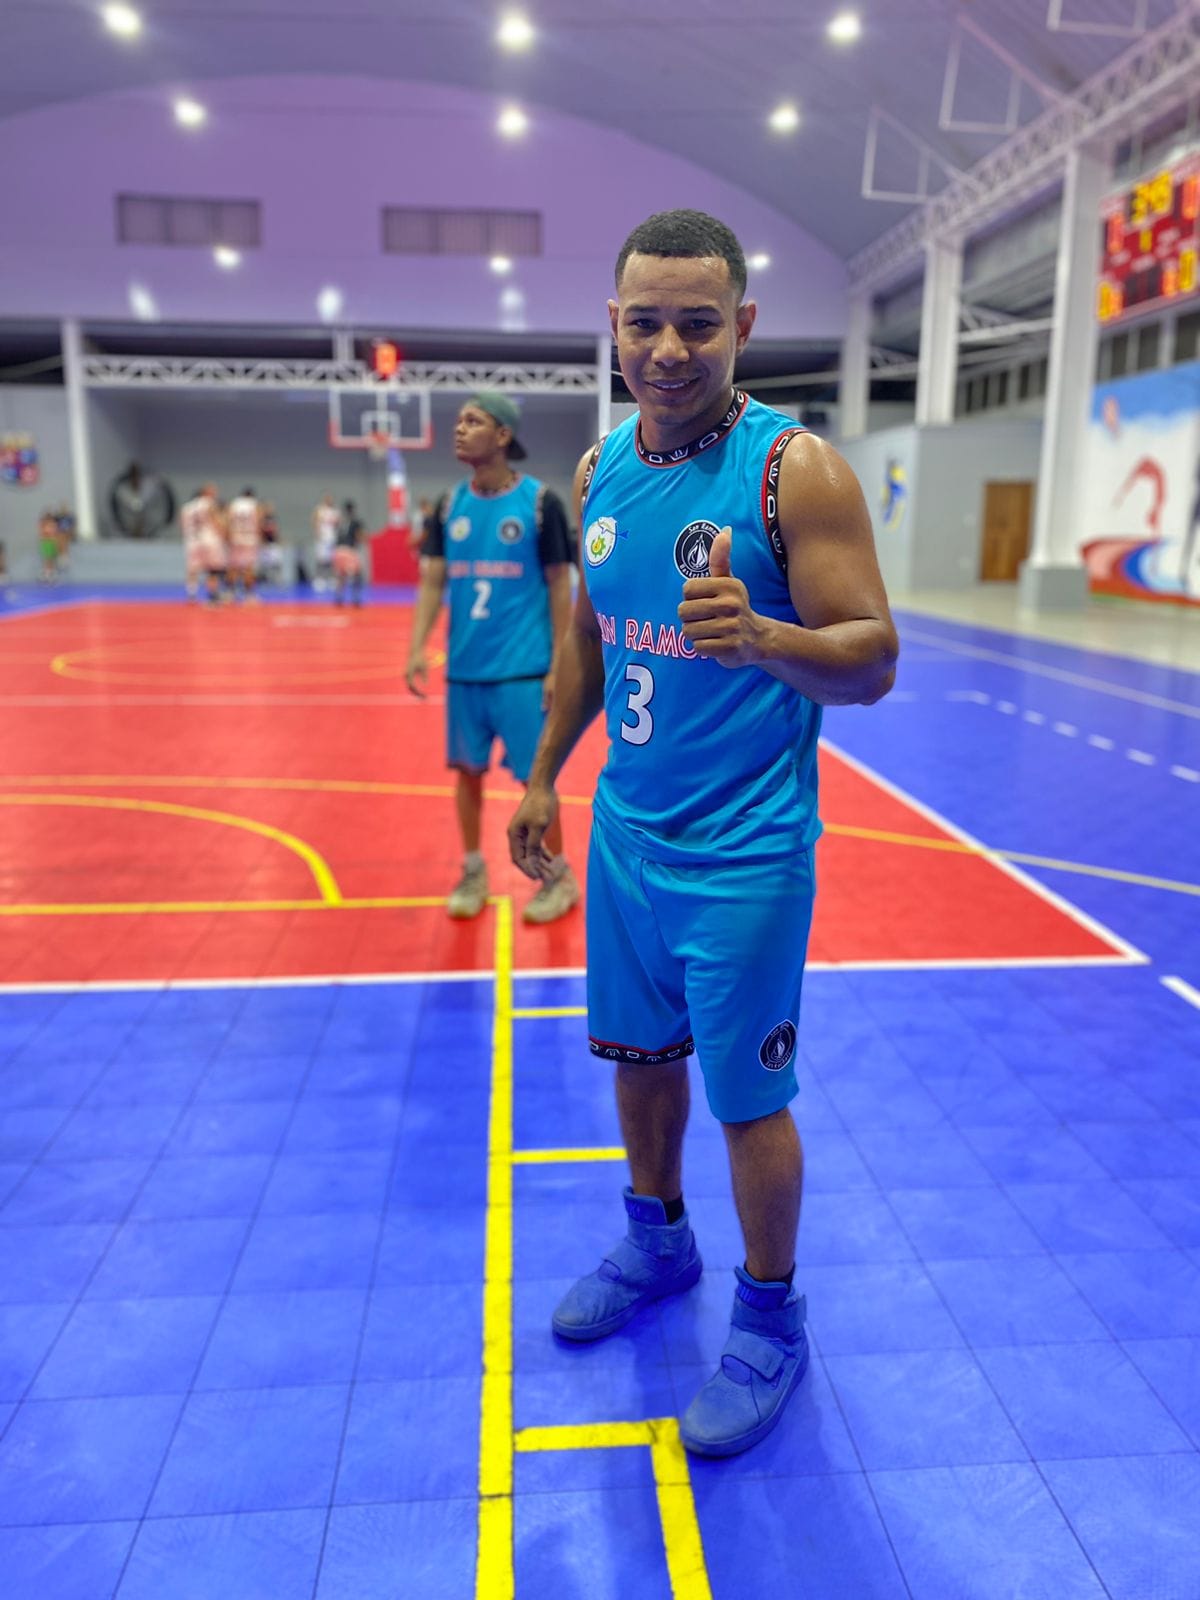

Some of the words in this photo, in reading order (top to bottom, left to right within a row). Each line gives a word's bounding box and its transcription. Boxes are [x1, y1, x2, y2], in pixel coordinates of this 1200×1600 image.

[470, 579, 493, 620] 2
[625, 618, 707, 659] RAMO
[620, 663, 655, 746] 3
